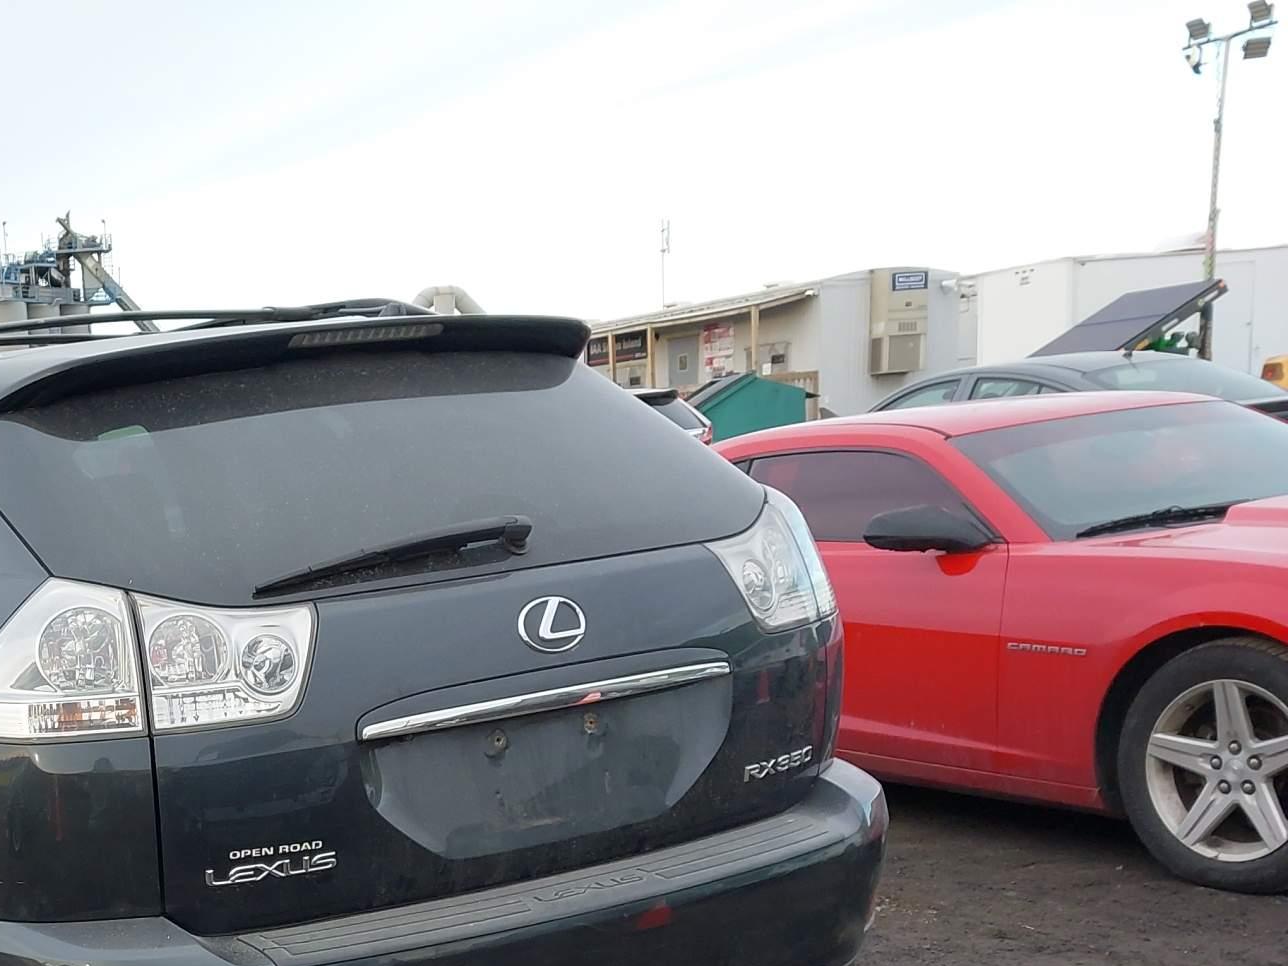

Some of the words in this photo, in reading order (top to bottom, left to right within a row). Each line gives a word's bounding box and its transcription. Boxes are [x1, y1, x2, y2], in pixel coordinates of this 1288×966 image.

[1007, 642, 1087, 656] CAMARO
[229, 846, 274, 860] OPEN
[278, 840, 323, 854] ROAD
[205, 851, 337, 886] LEXUS
[533, 873, 644, 902] LEXUS
